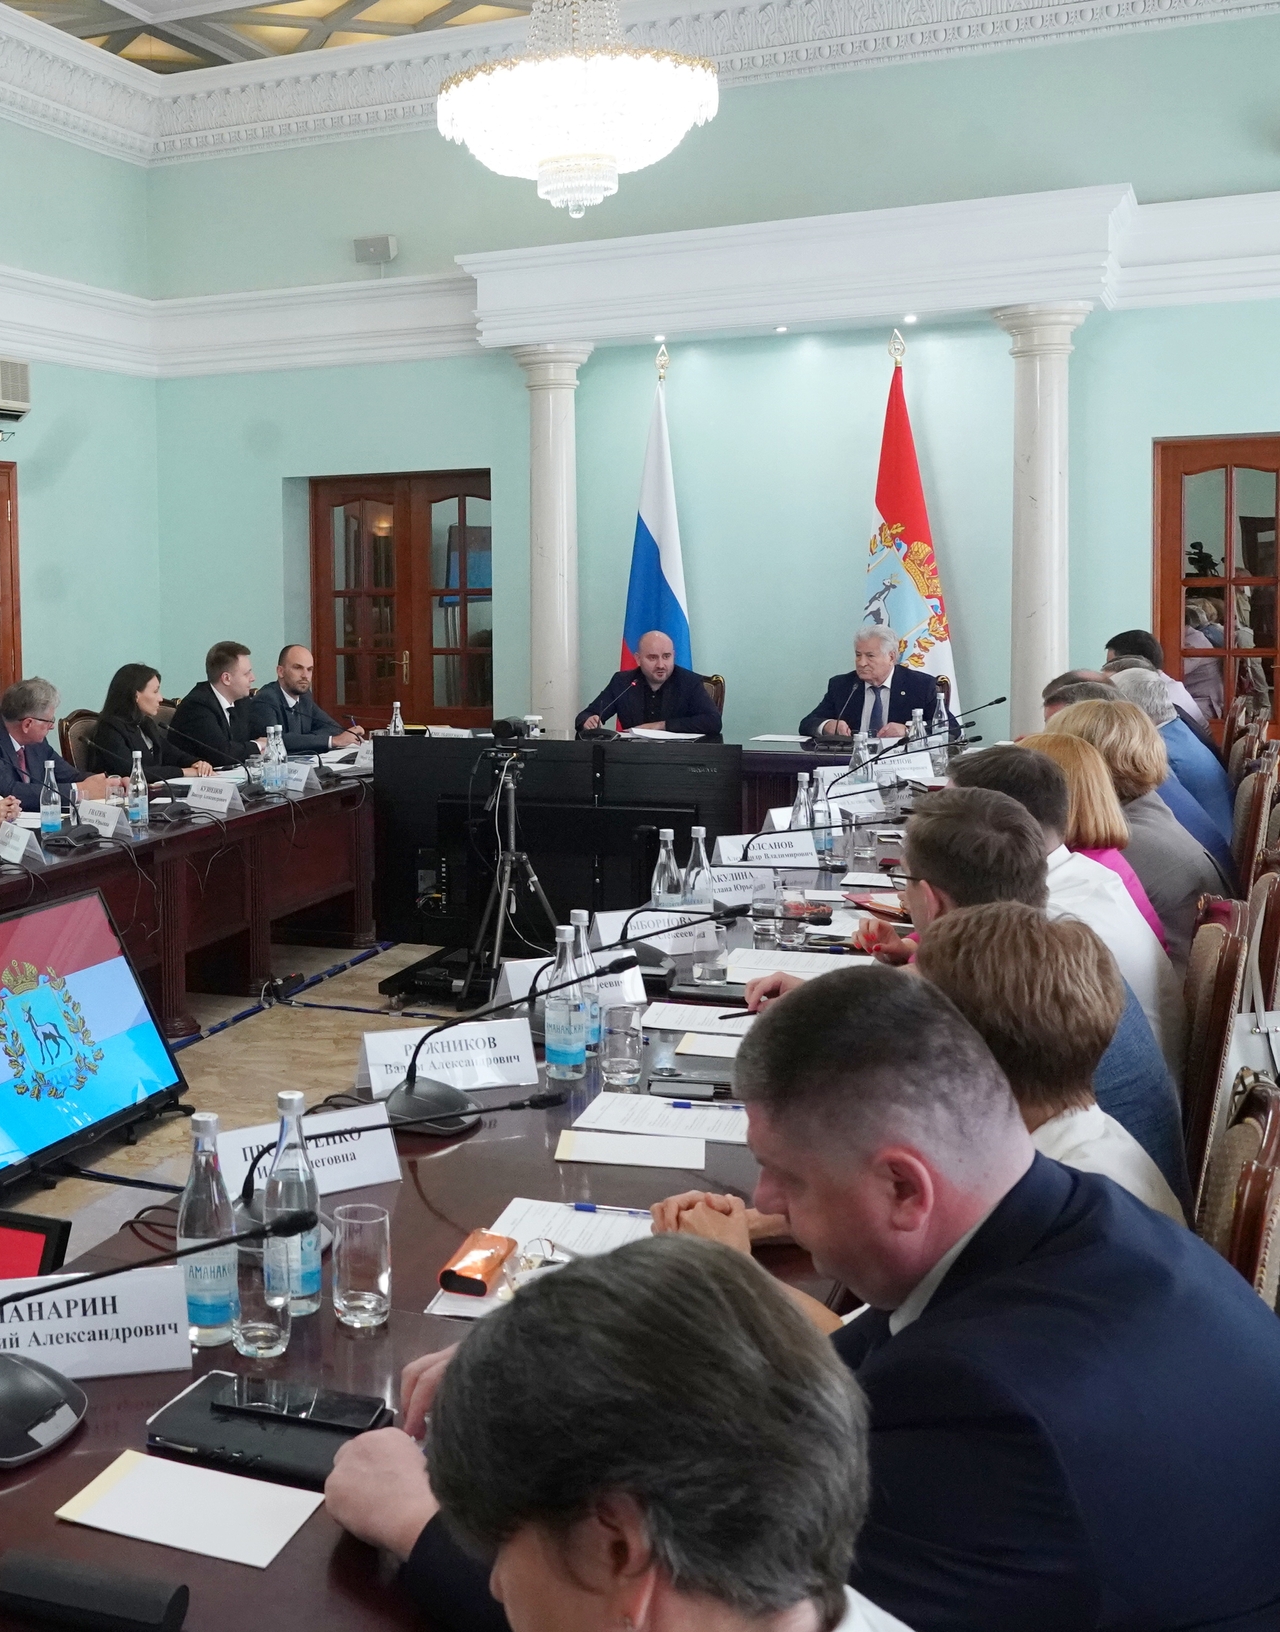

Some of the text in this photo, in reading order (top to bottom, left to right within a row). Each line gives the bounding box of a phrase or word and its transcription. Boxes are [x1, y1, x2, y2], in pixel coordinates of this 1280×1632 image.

[711, 871, 754, 883] АКУЛИНА
[622, 917, 694, 931] ЫБОРНОВА
[384, 1062, 424, 1075] Вадм
[310, 1151, 357, 1170] леговна
[27, 1321, 180, 1348] Александрович
